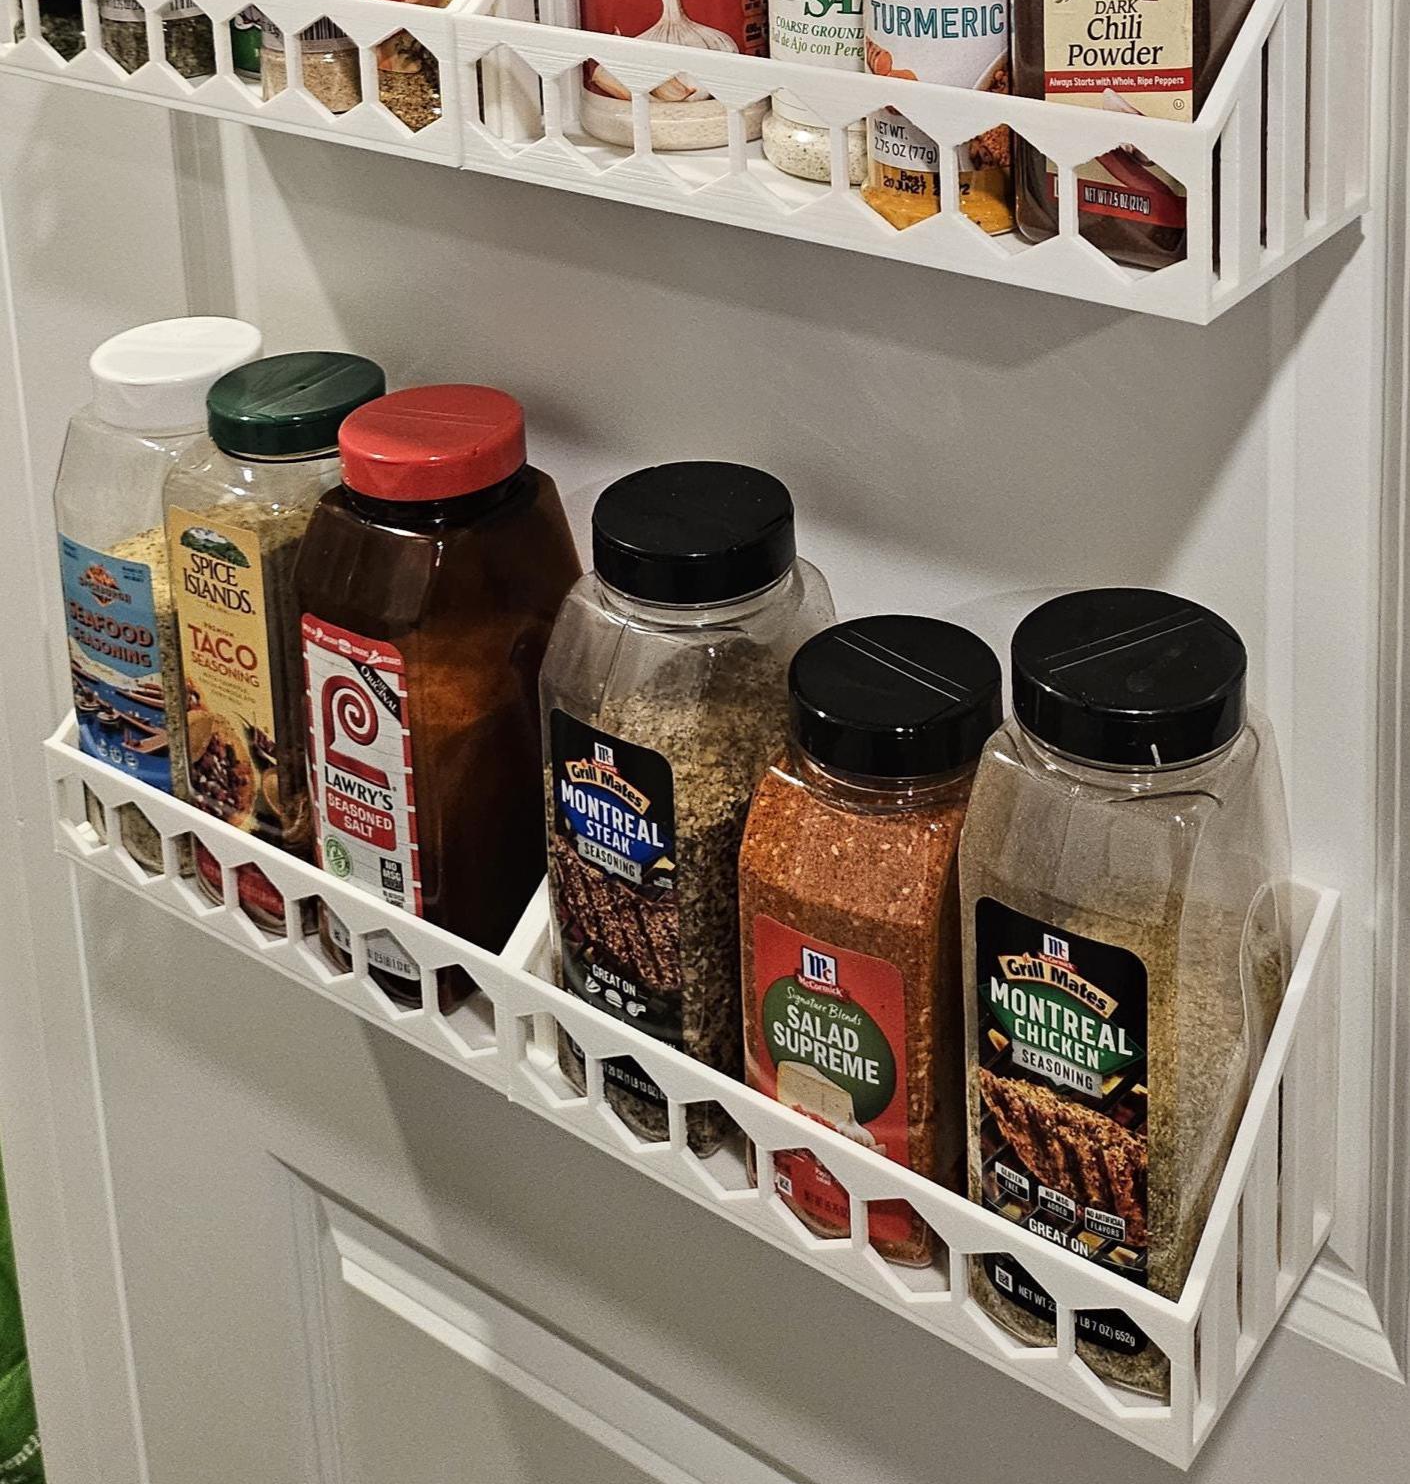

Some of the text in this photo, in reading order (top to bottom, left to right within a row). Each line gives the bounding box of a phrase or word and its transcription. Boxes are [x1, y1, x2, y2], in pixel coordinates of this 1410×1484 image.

[871, 0, 1004, 39] TURMERIC
[1095, 0, 1139, 15] DARK
[776, 16, 864, 40] COARSE GROUND
[782, 35, 831, 55] de Ajo con
[1087, 14, 1143, 41] Chili
[1067, 41, 1164, 67] Powder
[1050, 75, 1184, 88] Always Starts with Whole, Ripe Peppers
[875, 119, 908, 140] NET WT.
[875, 137, 938, 164] 2.75 OZ (77g)
[1085, 186, 1096, 202] NET
[1098, 189, 1107, 204] WT
[1109, 191, 1118, 206] 7.5
[1120, 193, 1128, 208] OZ
[190, 553, 238, 587] SPICE
[183, 568, 252, 614] ISLANDS
[69, 600, 154, 648] SEAFOOD
[73, 625, 153, 668] SEASONING
[187, 623, 258, 671] TACO
[191, 650, 260, 688] SEASONING
[360, 665, 399, 713] ORIGINAL
[324, 766, 393, 811] LAWRY'S
[571, 763, 597, 782] Grill
[601, 771, 643, 808] Mates
[328, 792, 393, 831] SEASONED
[344, 816, 373, 838] SALT
[561, 779, 664, 848] MONTREAL
[586, 819, 631, 856] STEAK
[383, 869, 401, 882] MSG
[385, 860, 398, 872] NO
[584, 842, 635, 878] SEASONING
[592, 964, 637, 997] GREAT ON
[797, 974, 843, 998] McCormick
[1006, 958, 1109, 1012] Grill Mates
[786, 986, 862, 1026] Signature Blends
[990, 976, 1133, 1057] MONTREAL
[786, 1004, 860, 1053] SALAD
[1014, 1017, 1099, 1070] CHICKEN
[773, 1021, 880, 1085] SUPREME
[1022, 1049, 1094, 1091] SEASONING
[1001, 1166, 1023, 1185] GLUTEN
[1047, 1202, 1068, 1218] ADDED
[1029, 1218, 1089, 1258] GREAT ON
[1090, 1221, 1121, 1238] FLAVORS
[1018, 1284, 1046, 1308] NET WT
[1080, 1316, 1136, 1348] LB 7 OZ) 652g
